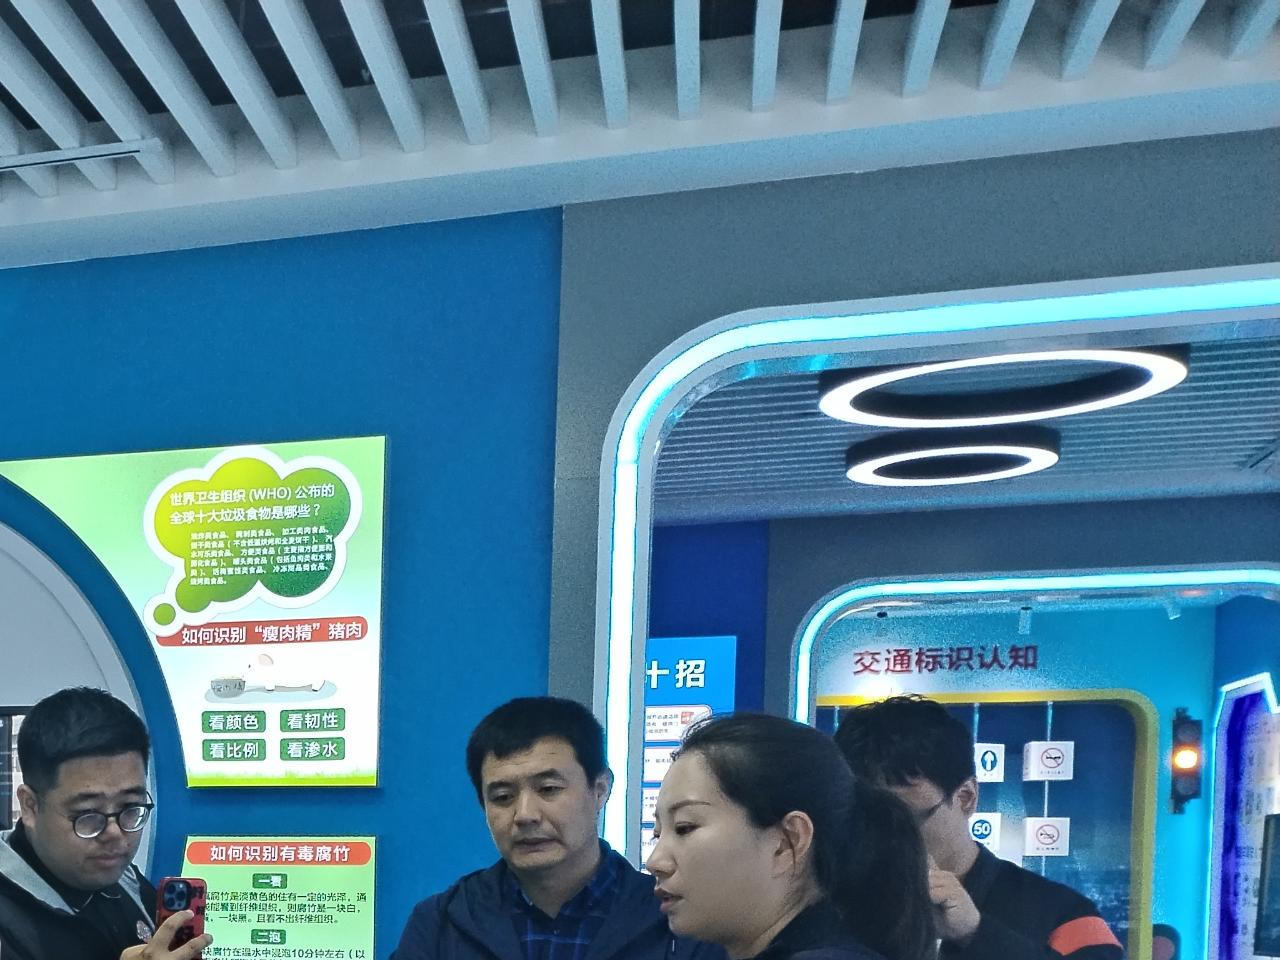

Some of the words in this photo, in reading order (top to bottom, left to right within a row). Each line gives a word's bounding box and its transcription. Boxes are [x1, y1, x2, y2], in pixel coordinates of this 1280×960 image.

[170, 503, 321, 526] 全球十大垃圾食物是哪些？
[853, 644, 1039, 676] 交通标识认知
[209, 713, 259, 730] 看颜色
[287, 712, 339, 730] 看韧性
[209, 742, 259, 759] 看比例
[287, 741, 338, 758] 看渗水
[973, 822, 991, 836] 50
[210, 845, 350, 863] 如何识别有毒腐竹
[258, 875, 282, 888] 一看
[257, 932, 282, 944] 二泡
